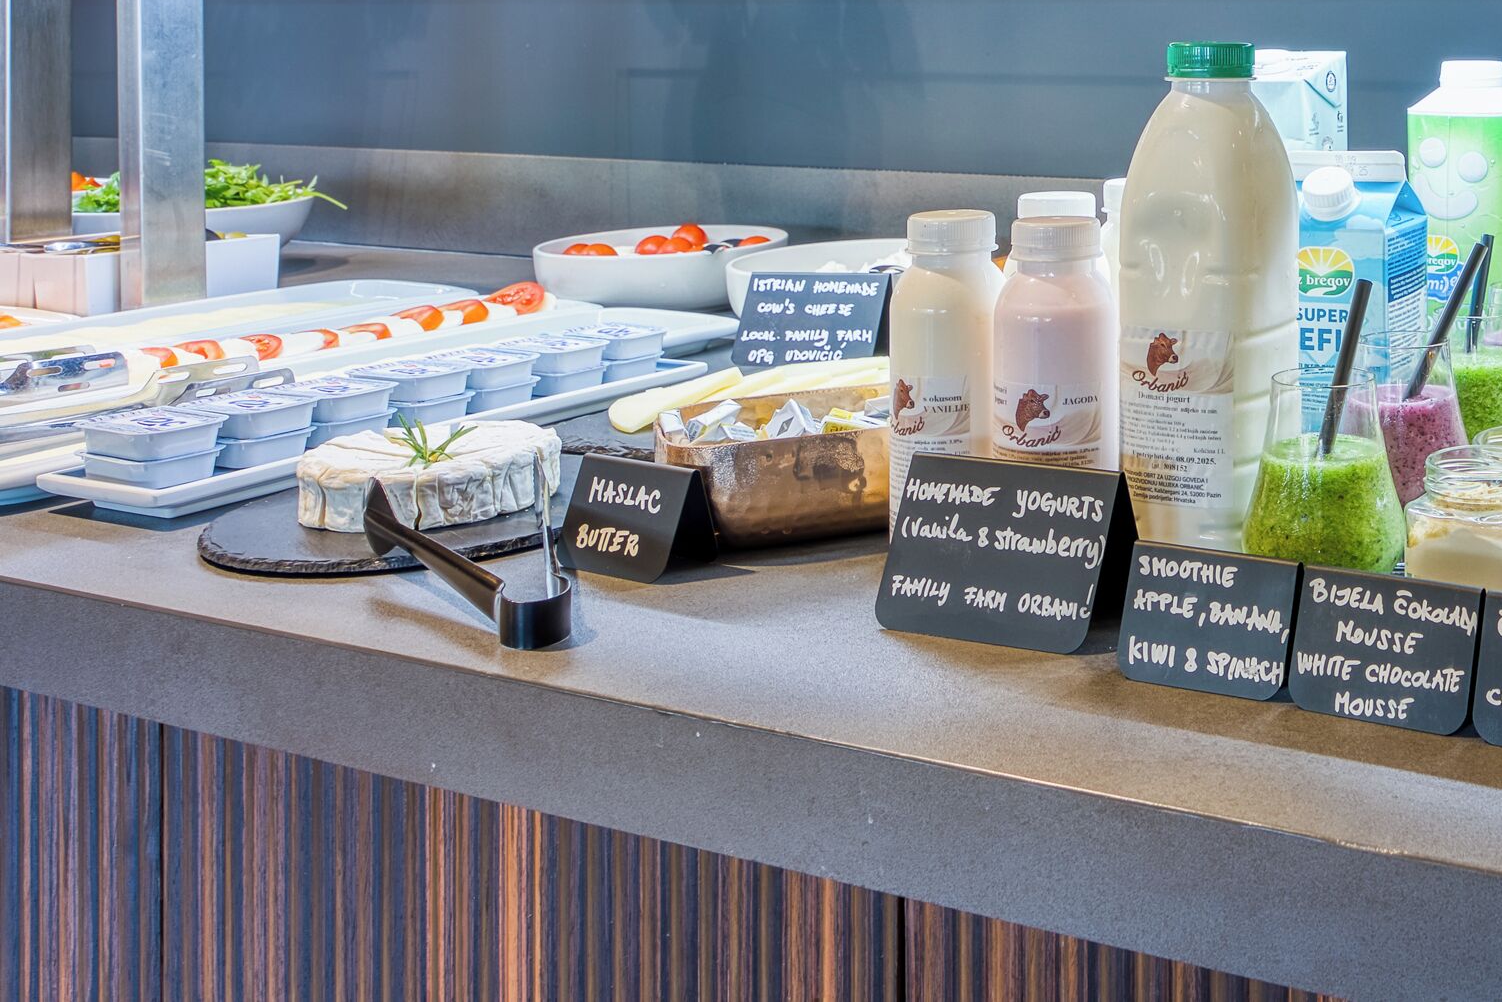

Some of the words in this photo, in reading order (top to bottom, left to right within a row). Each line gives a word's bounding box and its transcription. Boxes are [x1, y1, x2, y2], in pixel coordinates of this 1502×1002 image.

[752, 277, 807, 294] ISTRIAN
[1306, 274, 1351, 288] bregov
[756, 298, 796, 315] COW'S
[803, 302, 855, 317] CHEESE
[784, 328, 830, 348] FAMILY
[835, 328, 873, 344] FARM
[1299, 327, 1343, 353] EFI
[747, 347, 775, 365] OPG
[928, 394, 963, 403] okusom
[1062, 395, 1099, 406] JAGODA
[1166, 394, 1191, 404] jogurt
[890, 415, 926, 437] rbanić
[1001, 424, 1063, 448] Orbanić
[588, 475, 662, 515] MASLAC
[905, 477, 1000, 507] HOMEMADE
[1011, 488, 1104, 523] YOGURTS
[575, 522, 641, 558] BUTTER
[1138, 554, 1239, 589] SMOOTHIE
[890, 574, 951, 607] FAMILY
[964, 585, 1008, 613] FARM
[1309, 577, 1384, 616] BIJELA
[1335, 619, 1424, 655] MOUSSE
[1127, 635, 1176, 668] KIWI
[1206, 651, 1285, 687] SPINACH
[1296, 651, 1362, 682] WHITE
[1364, 662, 1466, 694] CHOCOLATE
[1334, 690, 1416, 721] MOUSSE
